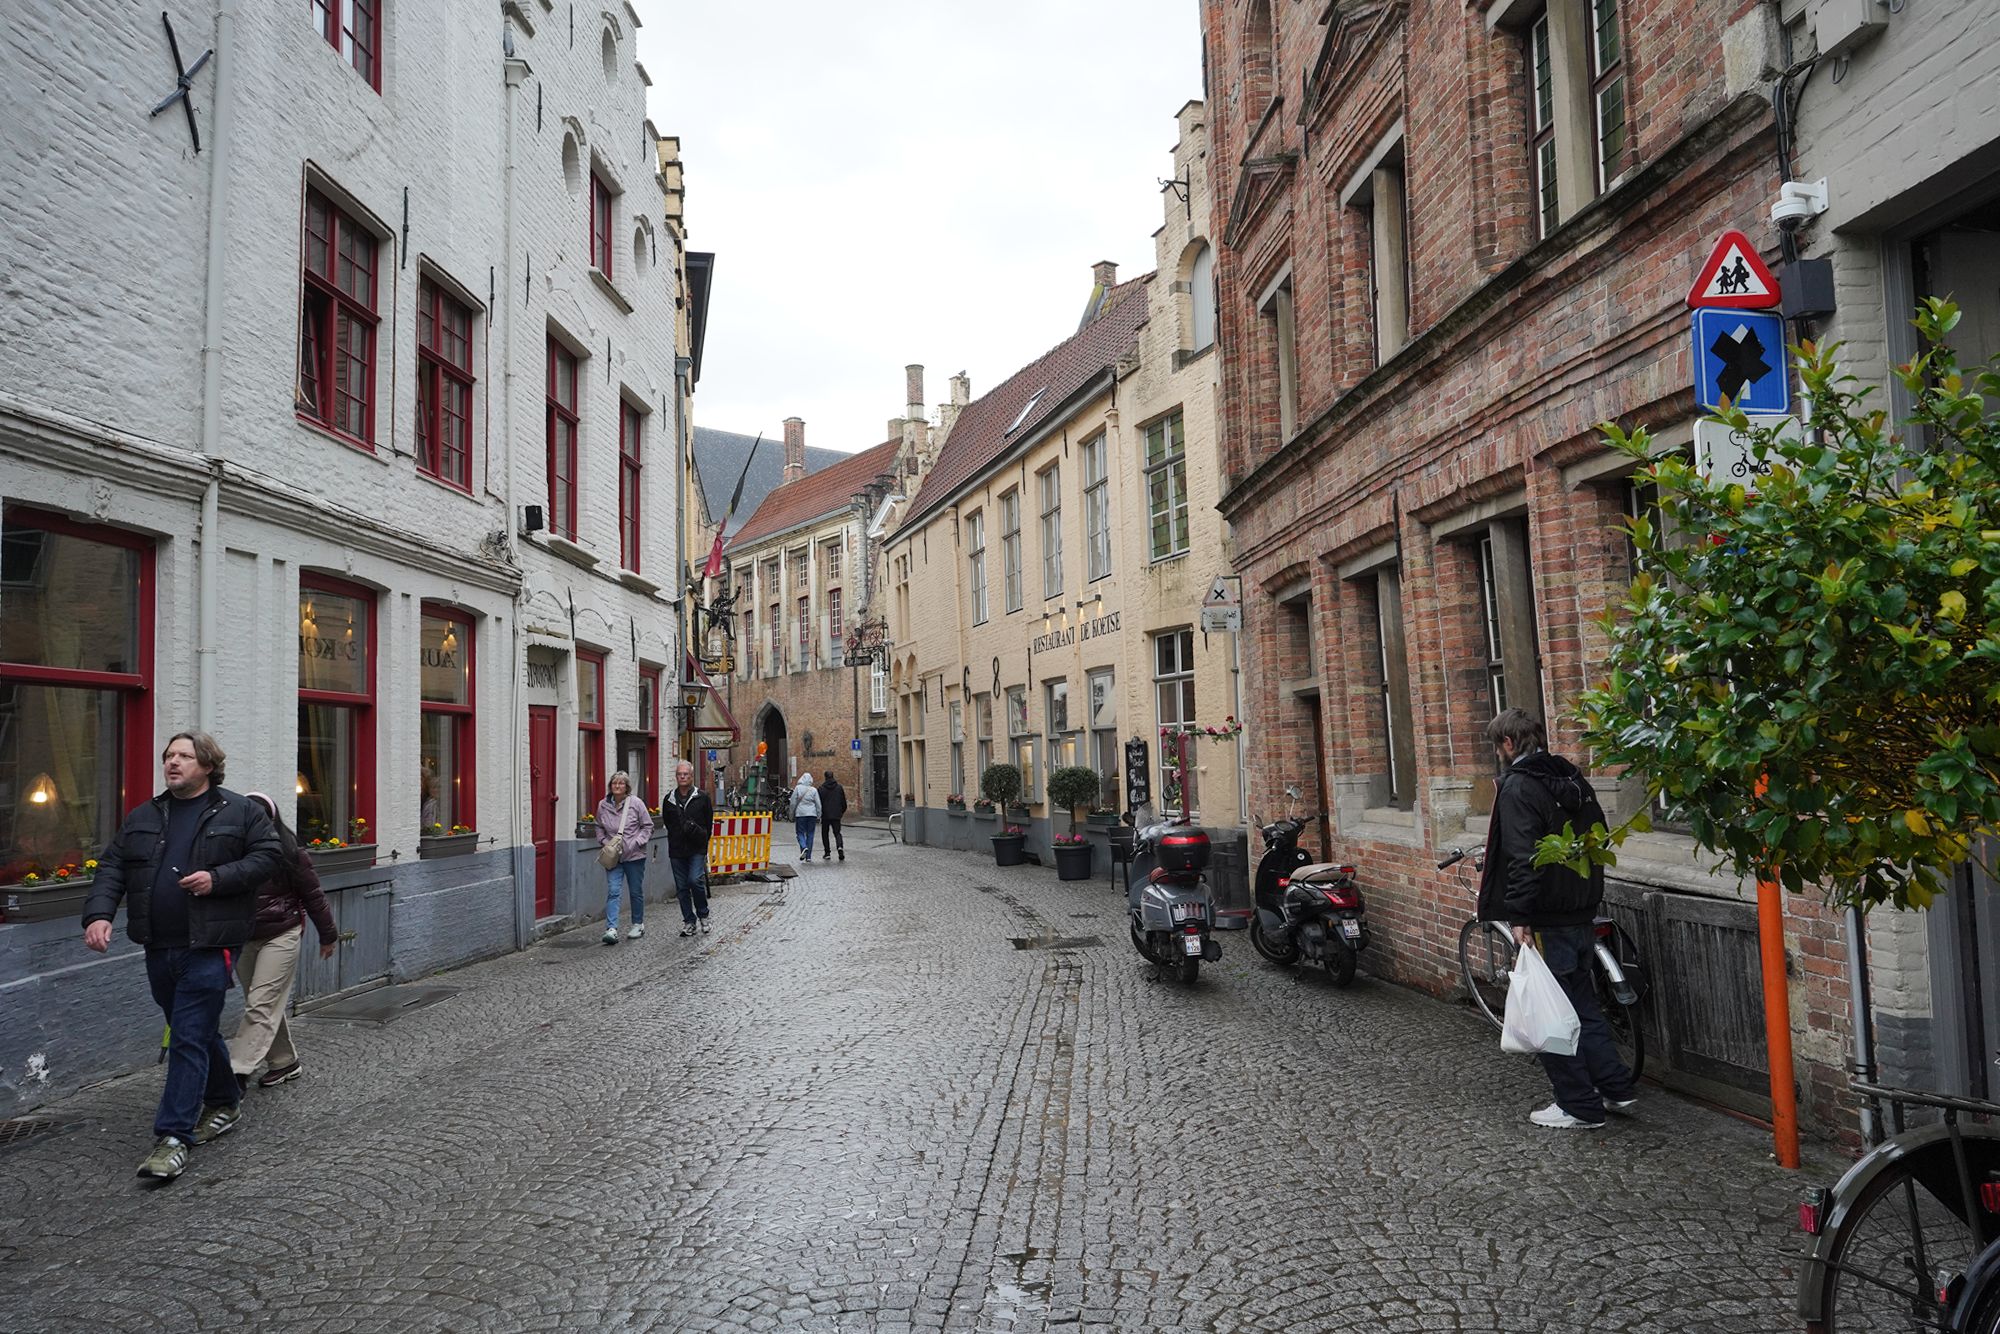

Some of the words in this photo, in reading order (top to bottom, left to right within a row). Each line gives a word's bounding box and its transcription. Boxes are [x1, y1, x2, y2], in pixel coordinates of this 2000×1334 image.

[1033, 626, 1076, 655] RESTAURANT
[1080, 621, 1090, 642] DE
[1092, 610, 1122, 638] KOETSE
